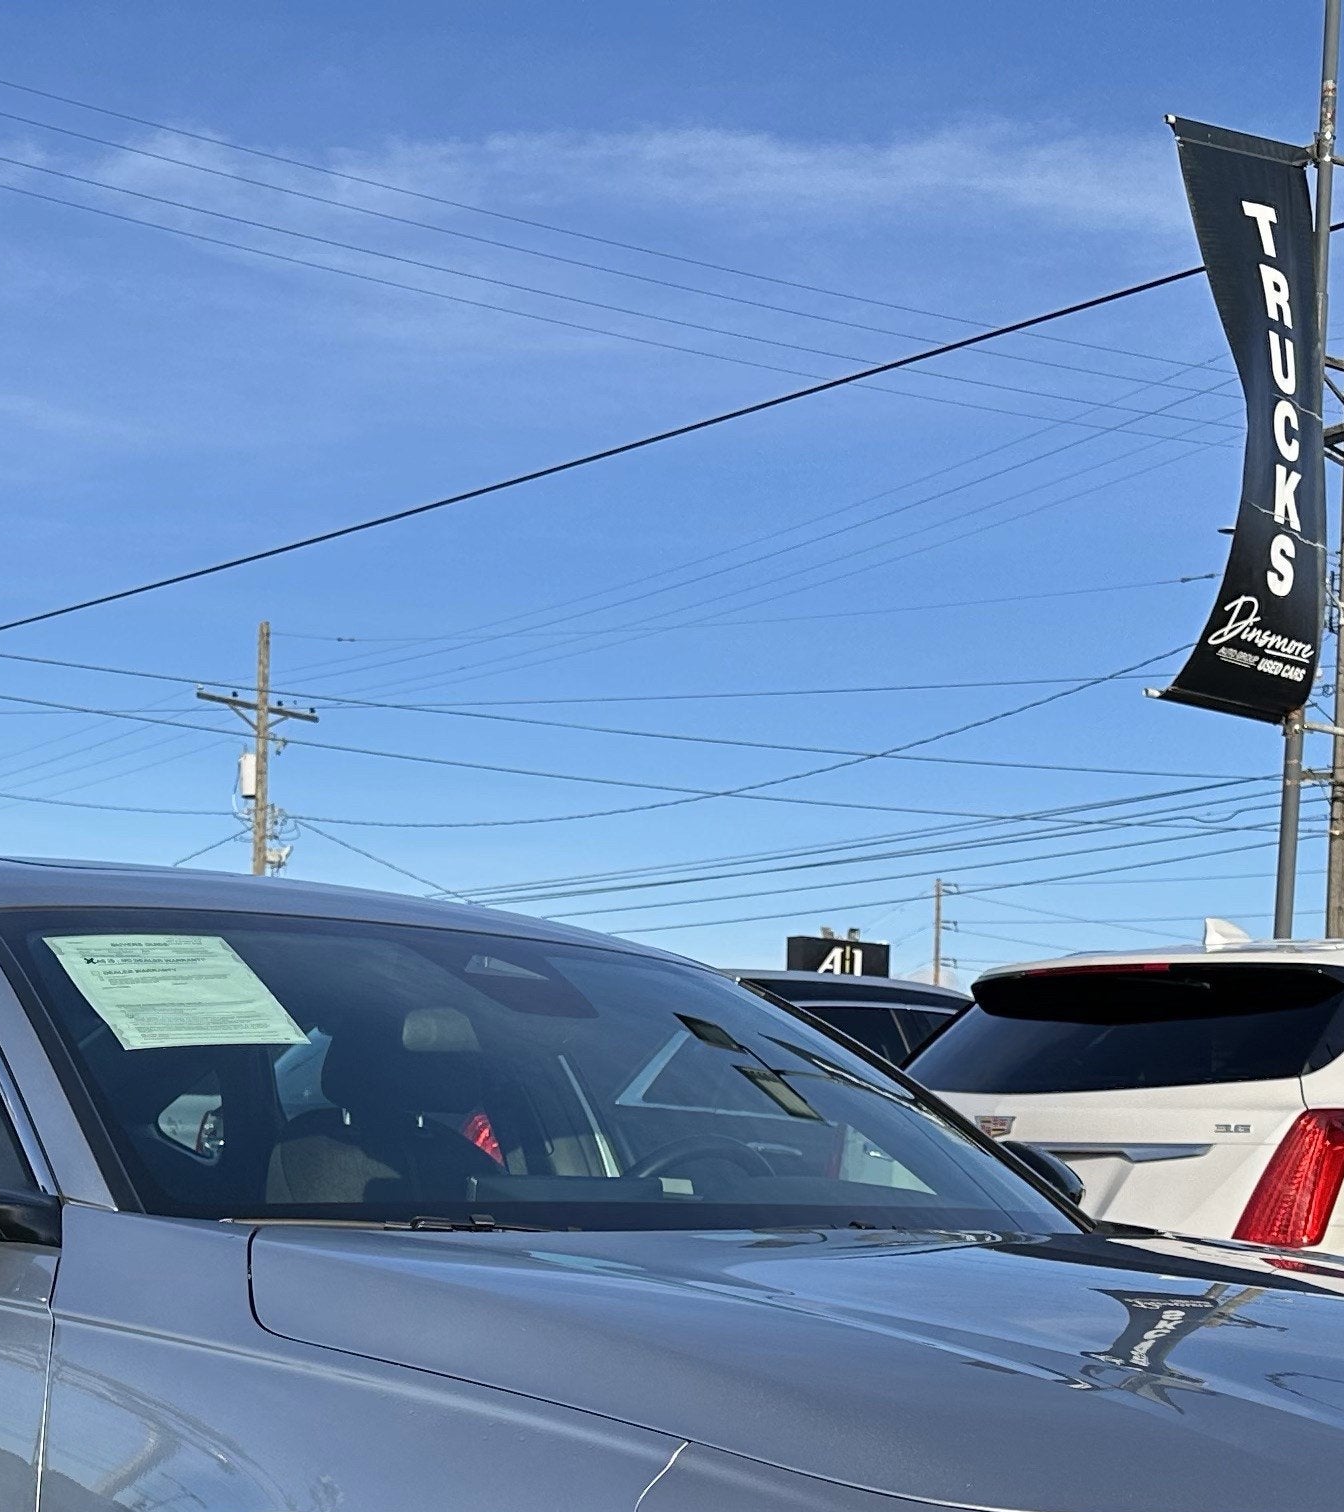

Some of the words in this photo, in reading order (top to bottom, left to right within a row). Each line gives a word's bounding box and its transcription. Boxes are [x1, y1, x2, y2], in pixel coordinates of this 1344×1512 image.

[1242, 201, 1301, 596] TRUCKS
[1208, 595, 1314, 659] Dinsmore
[1257, 658, 1283, 675] USED
[1281, 664, 1306, 682] CARS
